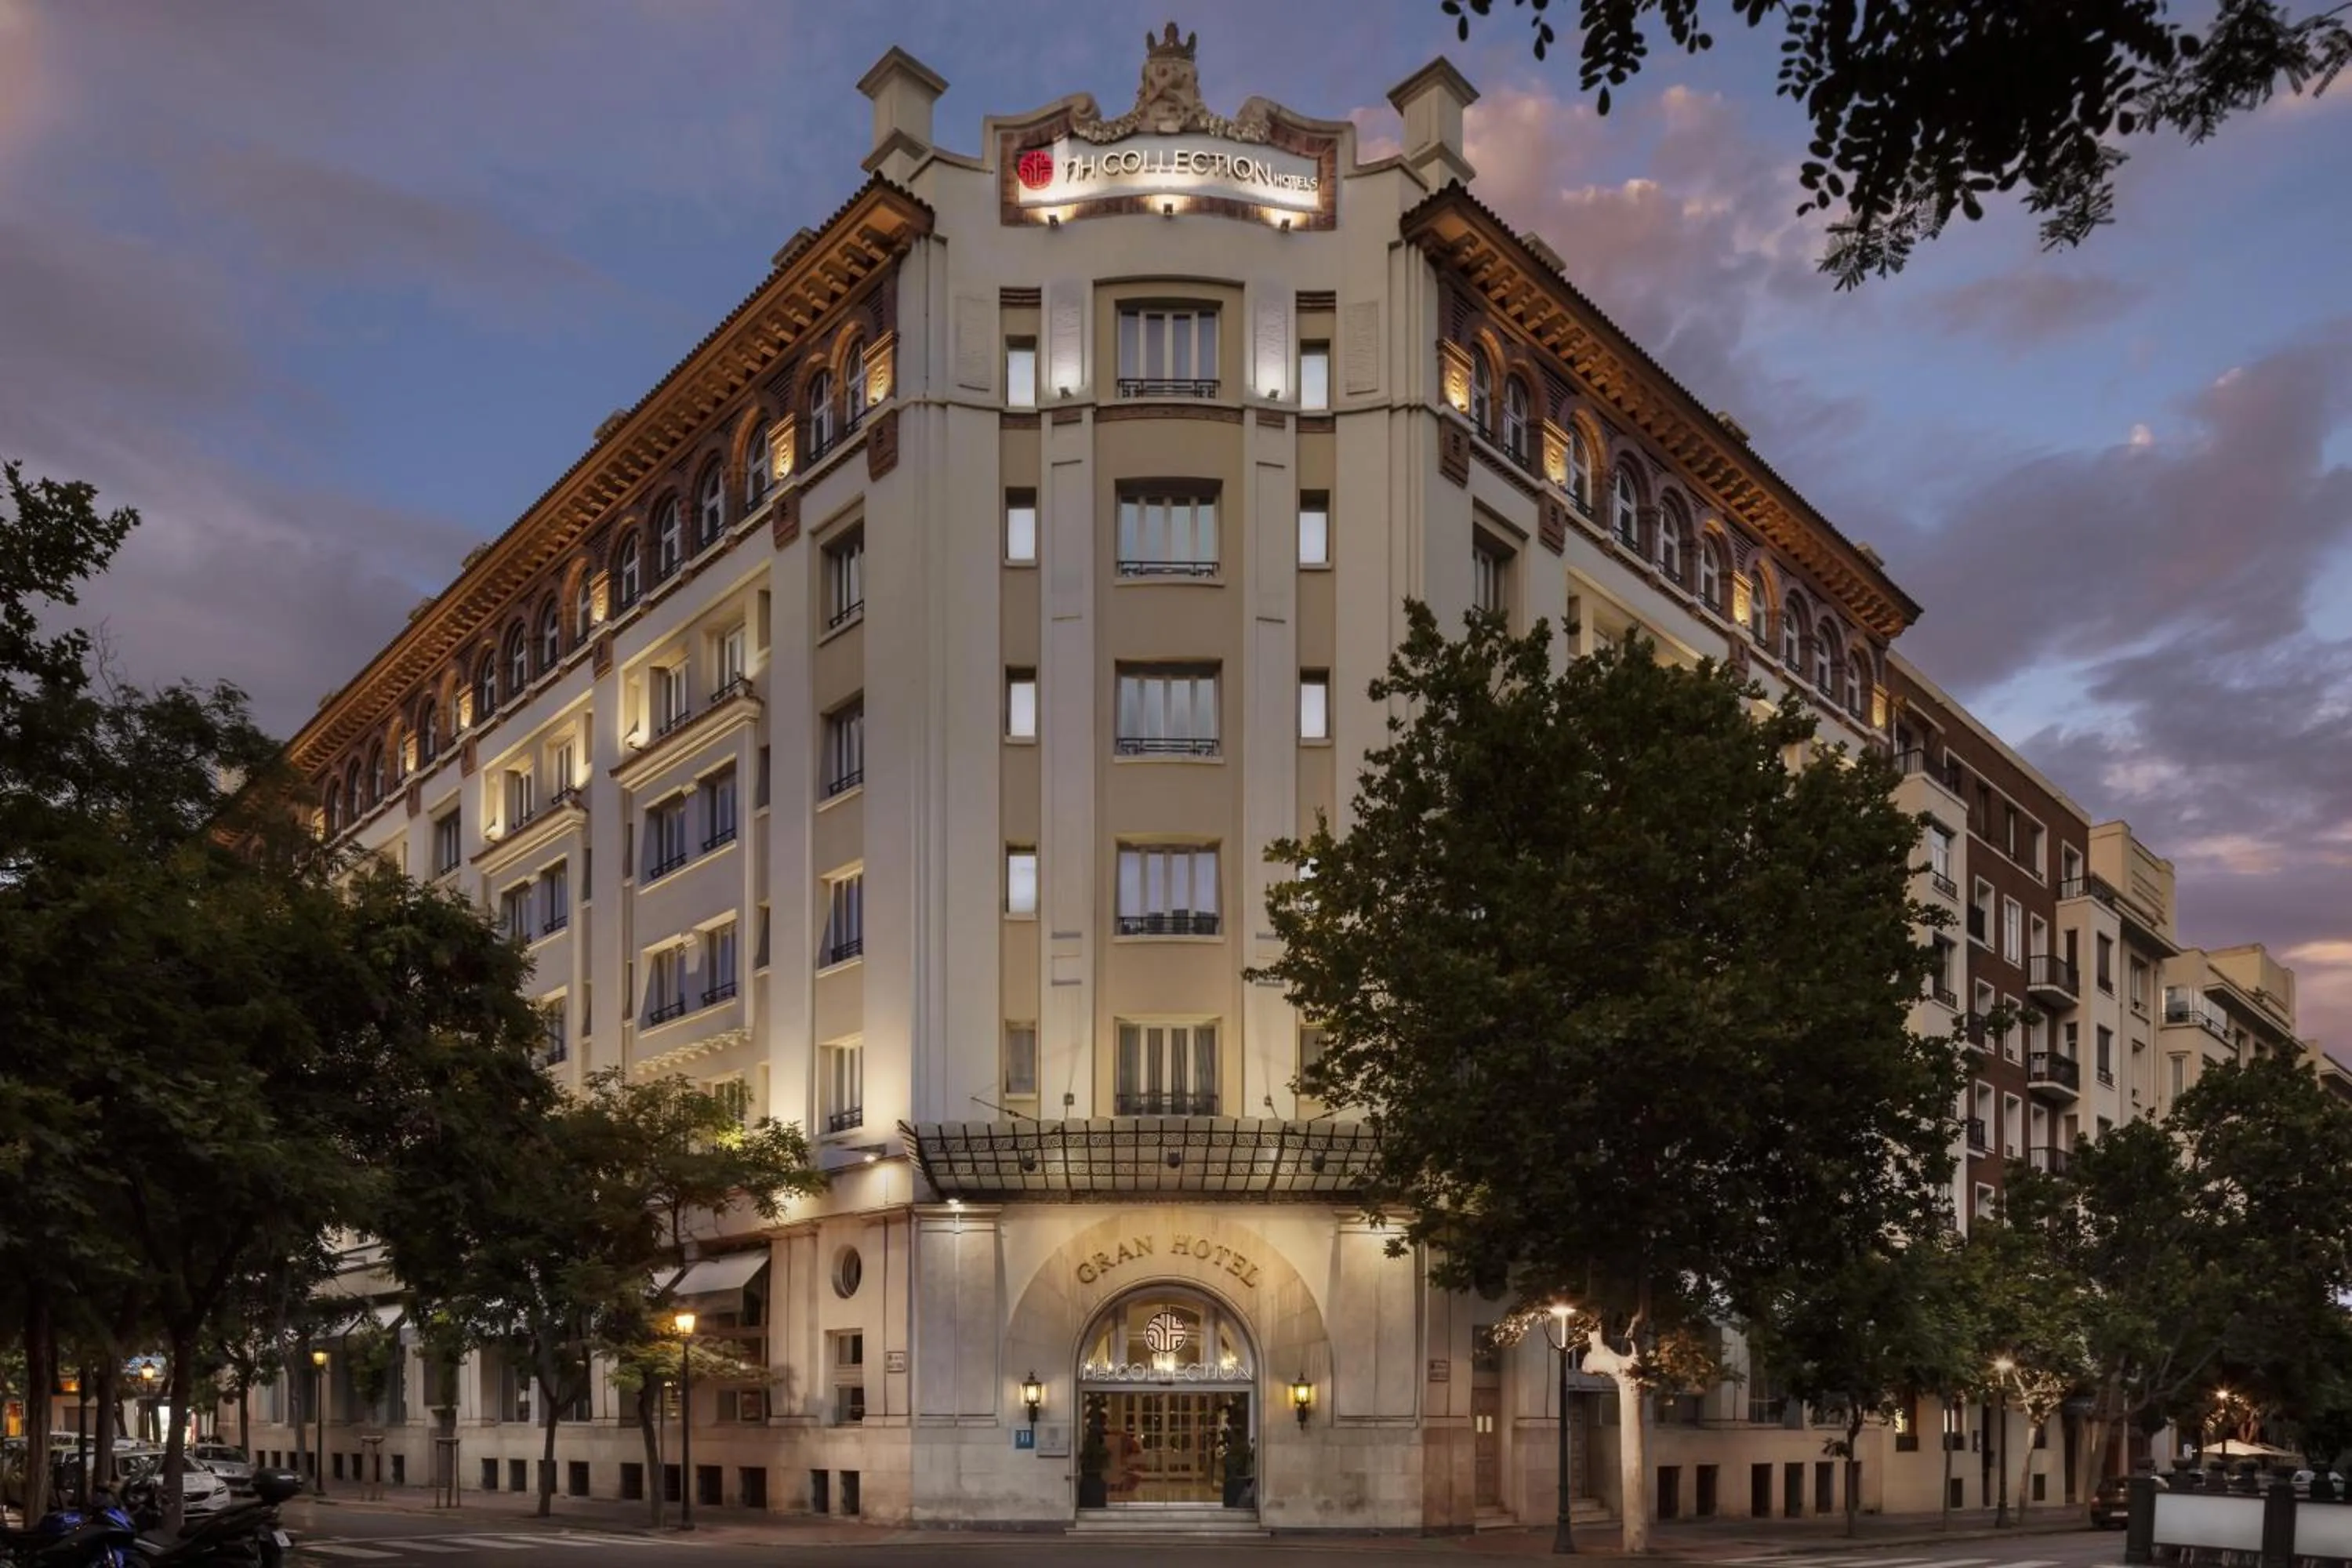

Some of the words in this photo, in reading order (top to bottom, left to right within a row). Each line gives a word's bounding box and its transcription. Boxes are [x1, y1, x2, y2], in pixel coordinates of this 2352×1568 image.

[1102, 149, 1274, 187] COLLECTION
[1273, 172, 1319, 192] HOTELS
[1076, 1235, 1153, 1284] GRAN
[1171, 1234, 1258, 1289] HOTEL
